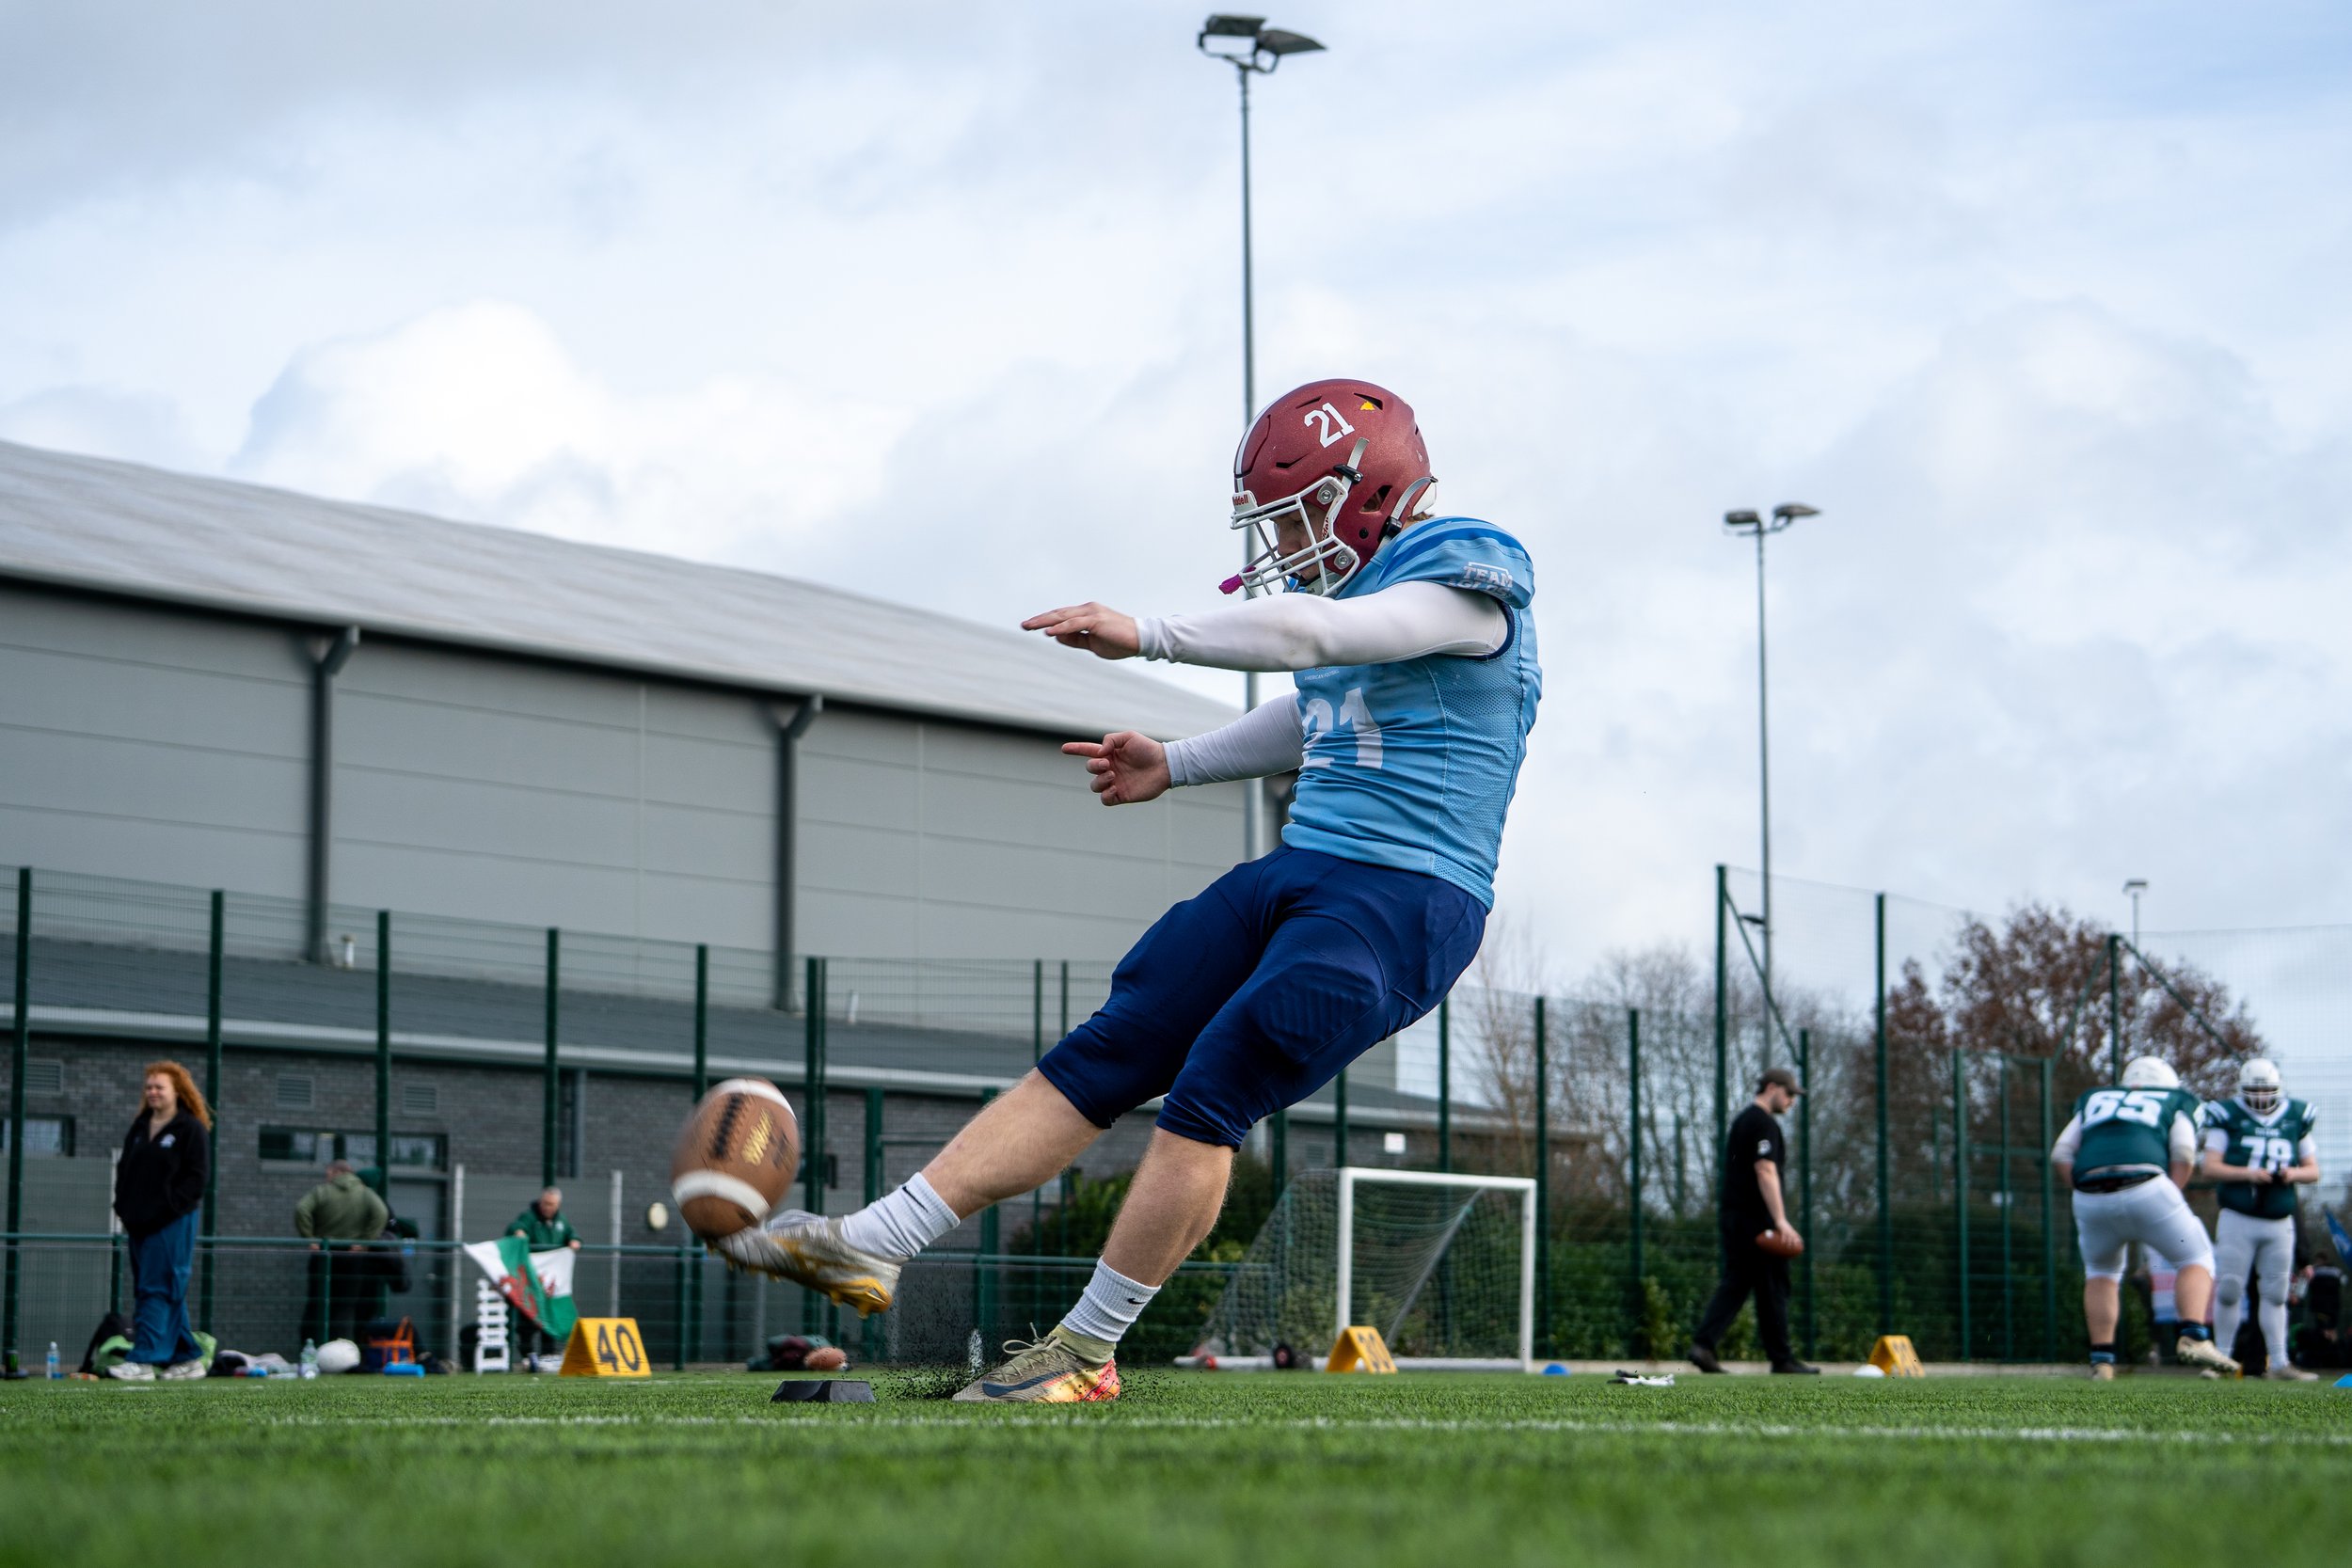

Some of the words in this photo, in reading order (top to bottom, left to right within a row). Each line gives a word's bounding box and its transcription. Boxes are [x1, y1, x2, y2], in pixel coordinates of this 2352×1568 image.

[1304, 403, 1356, 449] 21
[1463, 565, 1513, 588] TEAM
[1300, 687, 1384, 769] 21
[2083, 1090, 2170, 1129] 65
[2239, 1134, 2292, 1173] 78
[597, 1323, 641, 1372] 40
